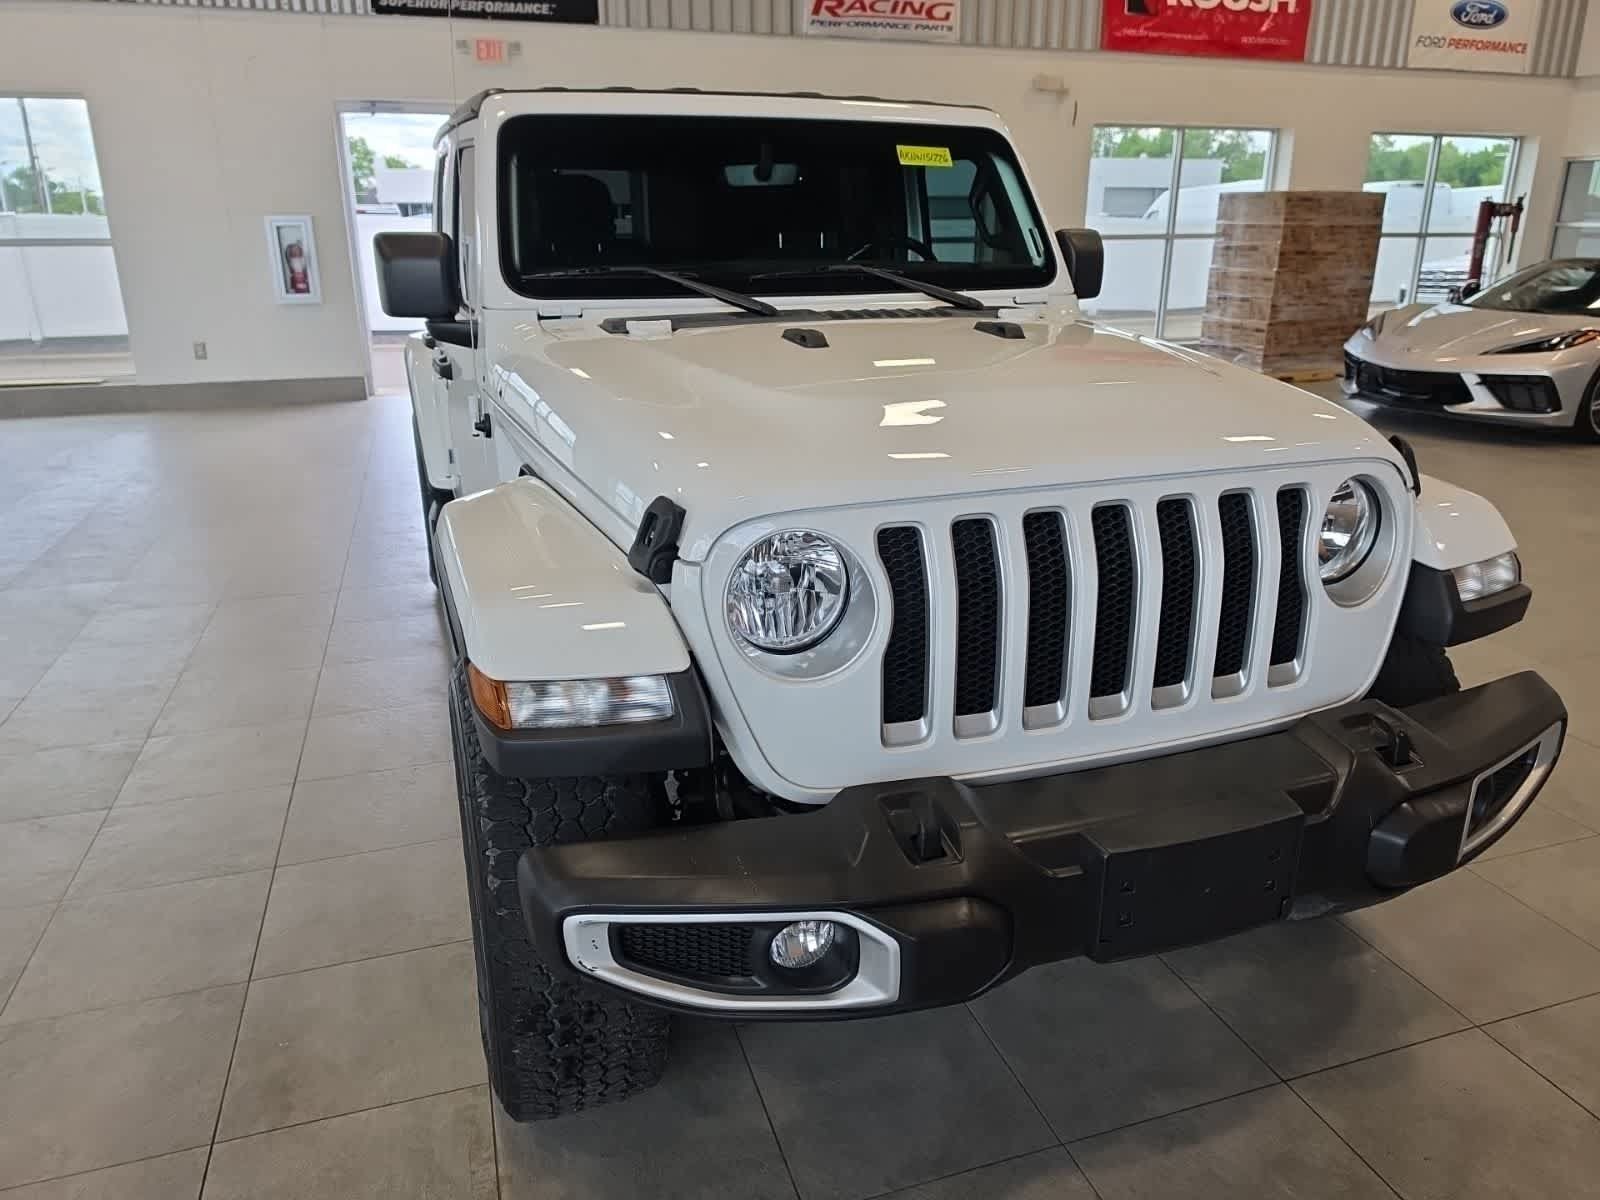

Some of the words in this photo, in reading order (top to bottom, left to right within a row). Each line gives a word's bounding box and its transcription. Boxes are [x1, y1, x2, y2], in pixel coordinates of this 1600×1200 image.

[378, 0, 448, 9] SUPERIOR
[811, 0, 955, 21] RACING
[1166, 0, 1297, 14] USH
[1460, 2, 1498, 24] Ford
[810, 19, 911, 30] PERFORMANCE
[914, 23, 953, 32] PARTS
[475, 40, 504, 60] EXIT
[1415, 35, 1447, 48] FORD
[1447, 38, 1528, 54] PERFORMANCE
